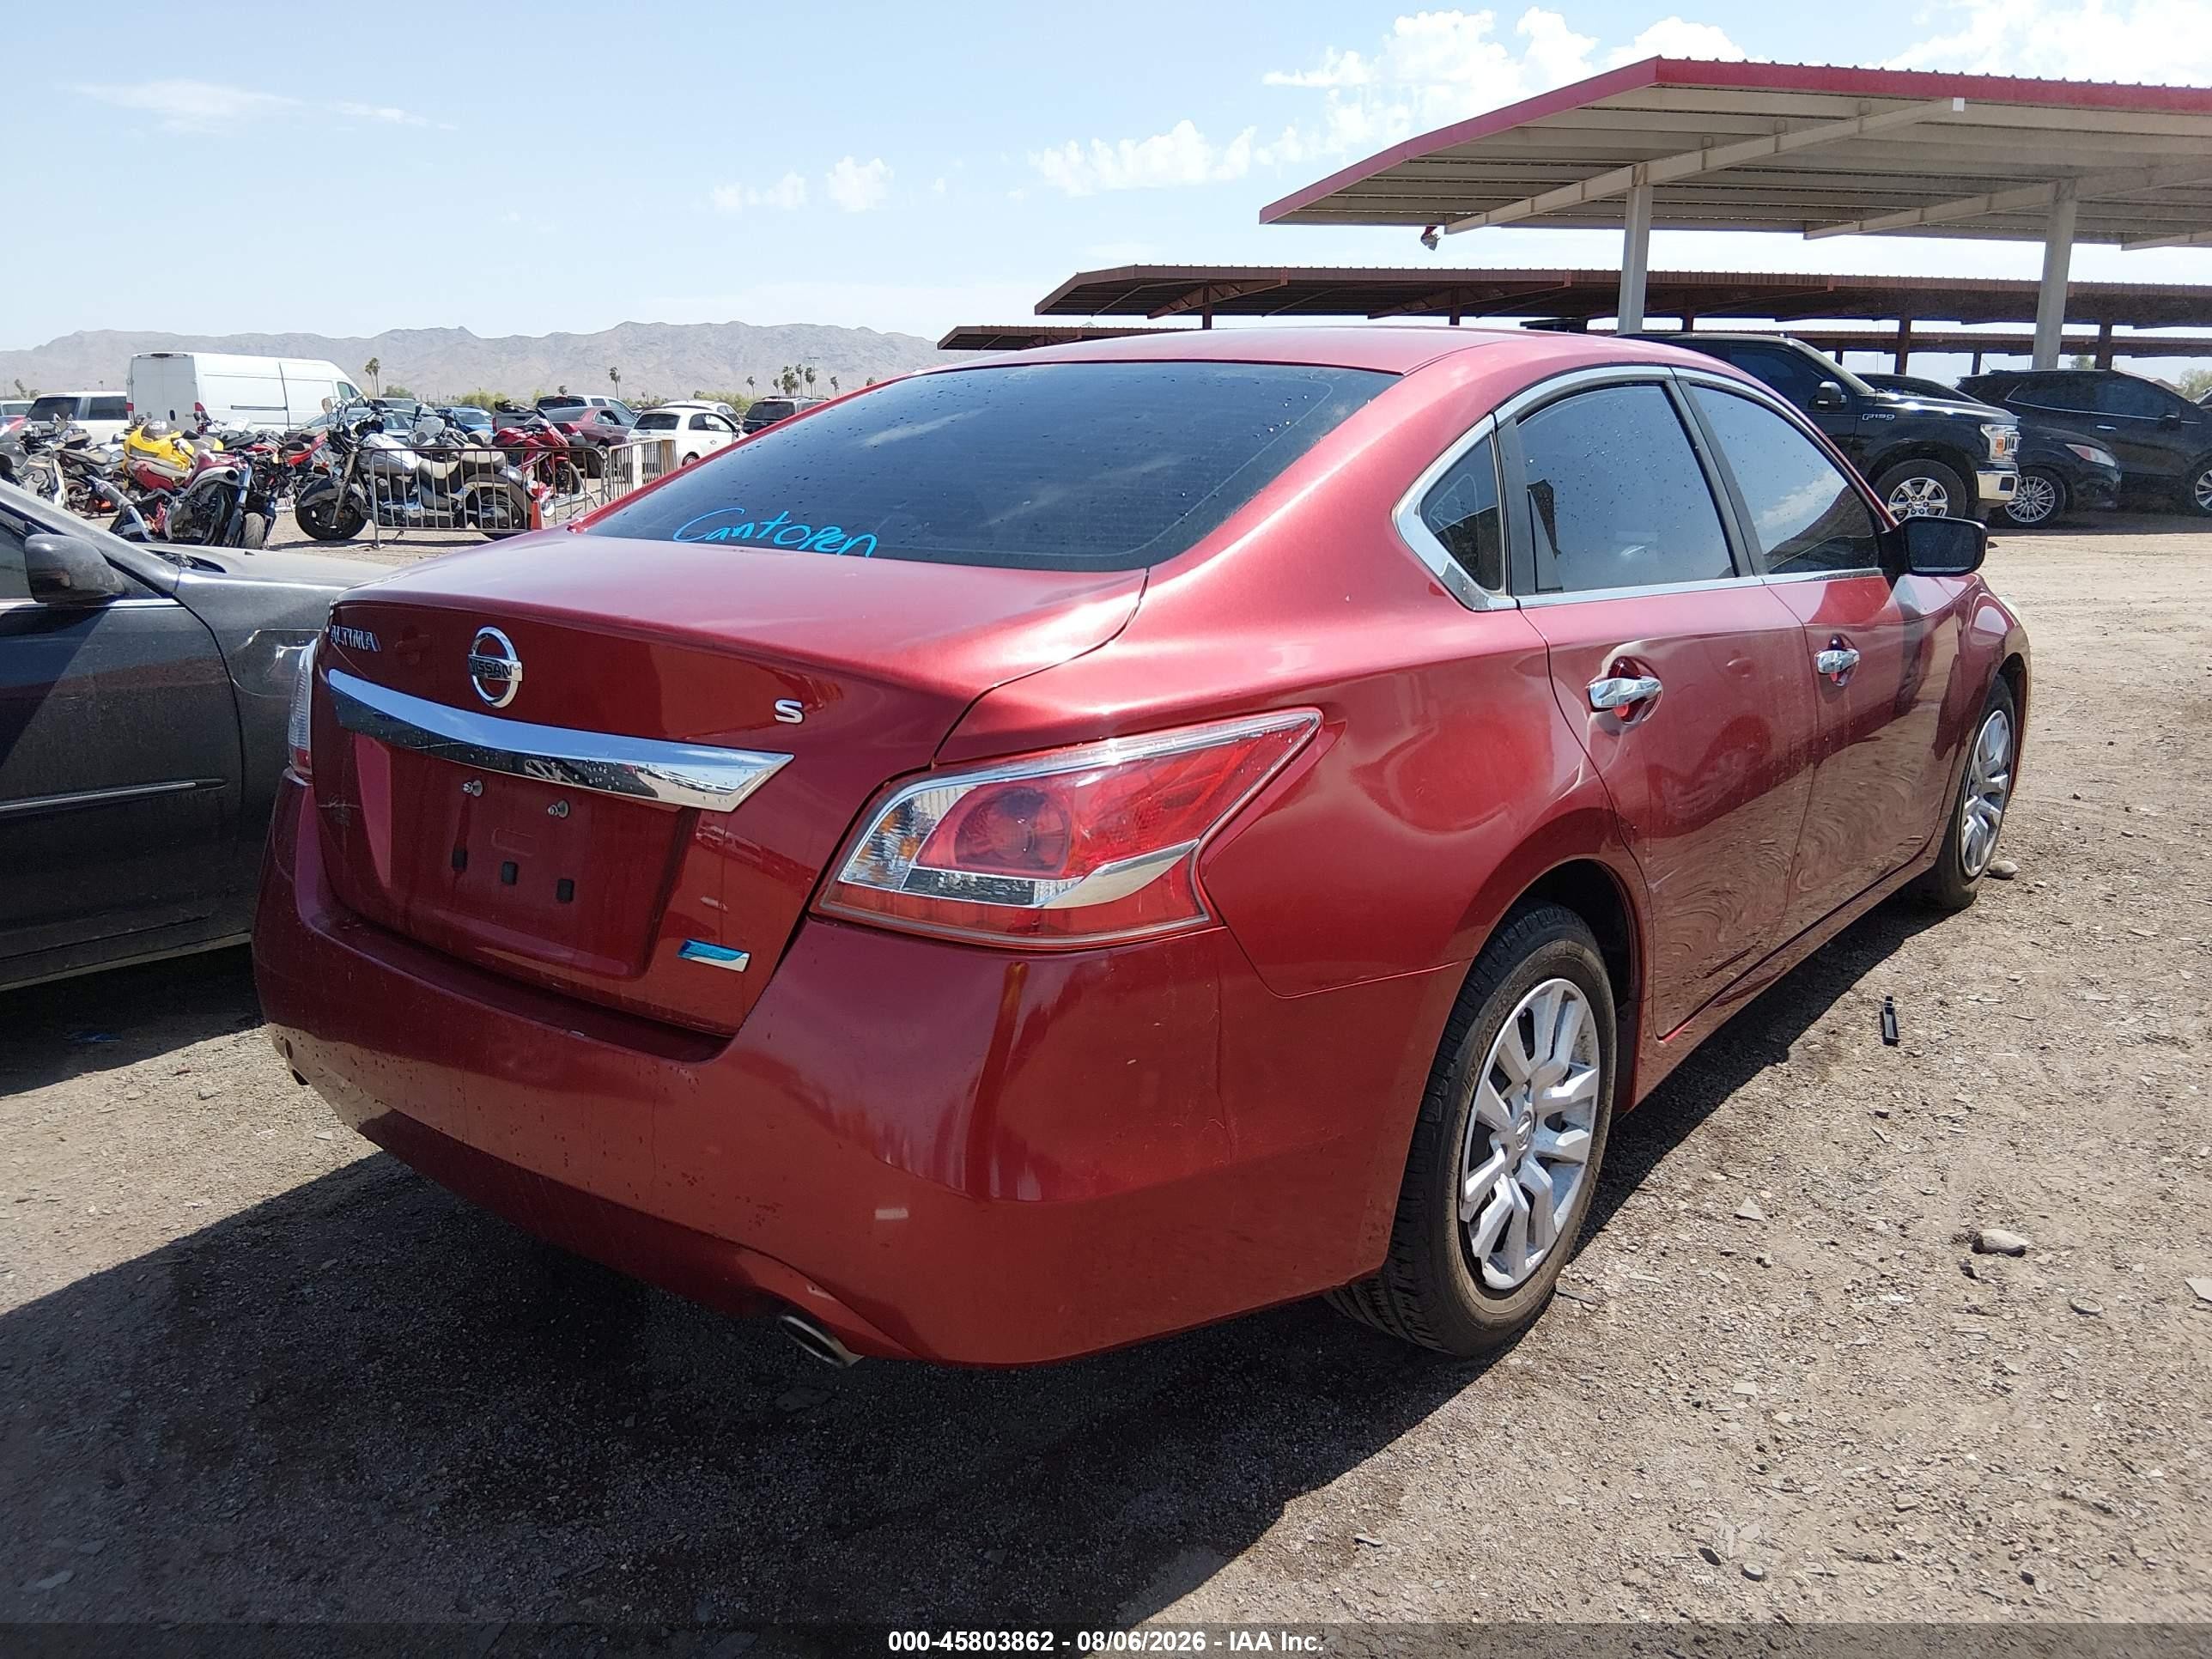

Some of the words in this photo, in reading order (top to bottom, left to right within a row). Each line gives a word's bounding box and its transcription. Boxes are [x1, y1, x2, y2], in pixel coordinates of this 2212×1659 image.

[330, 624, 381, 652] ALTIMA
[469, 658, 514, 678] NISSAN
[775, 699, 803, 723] S
